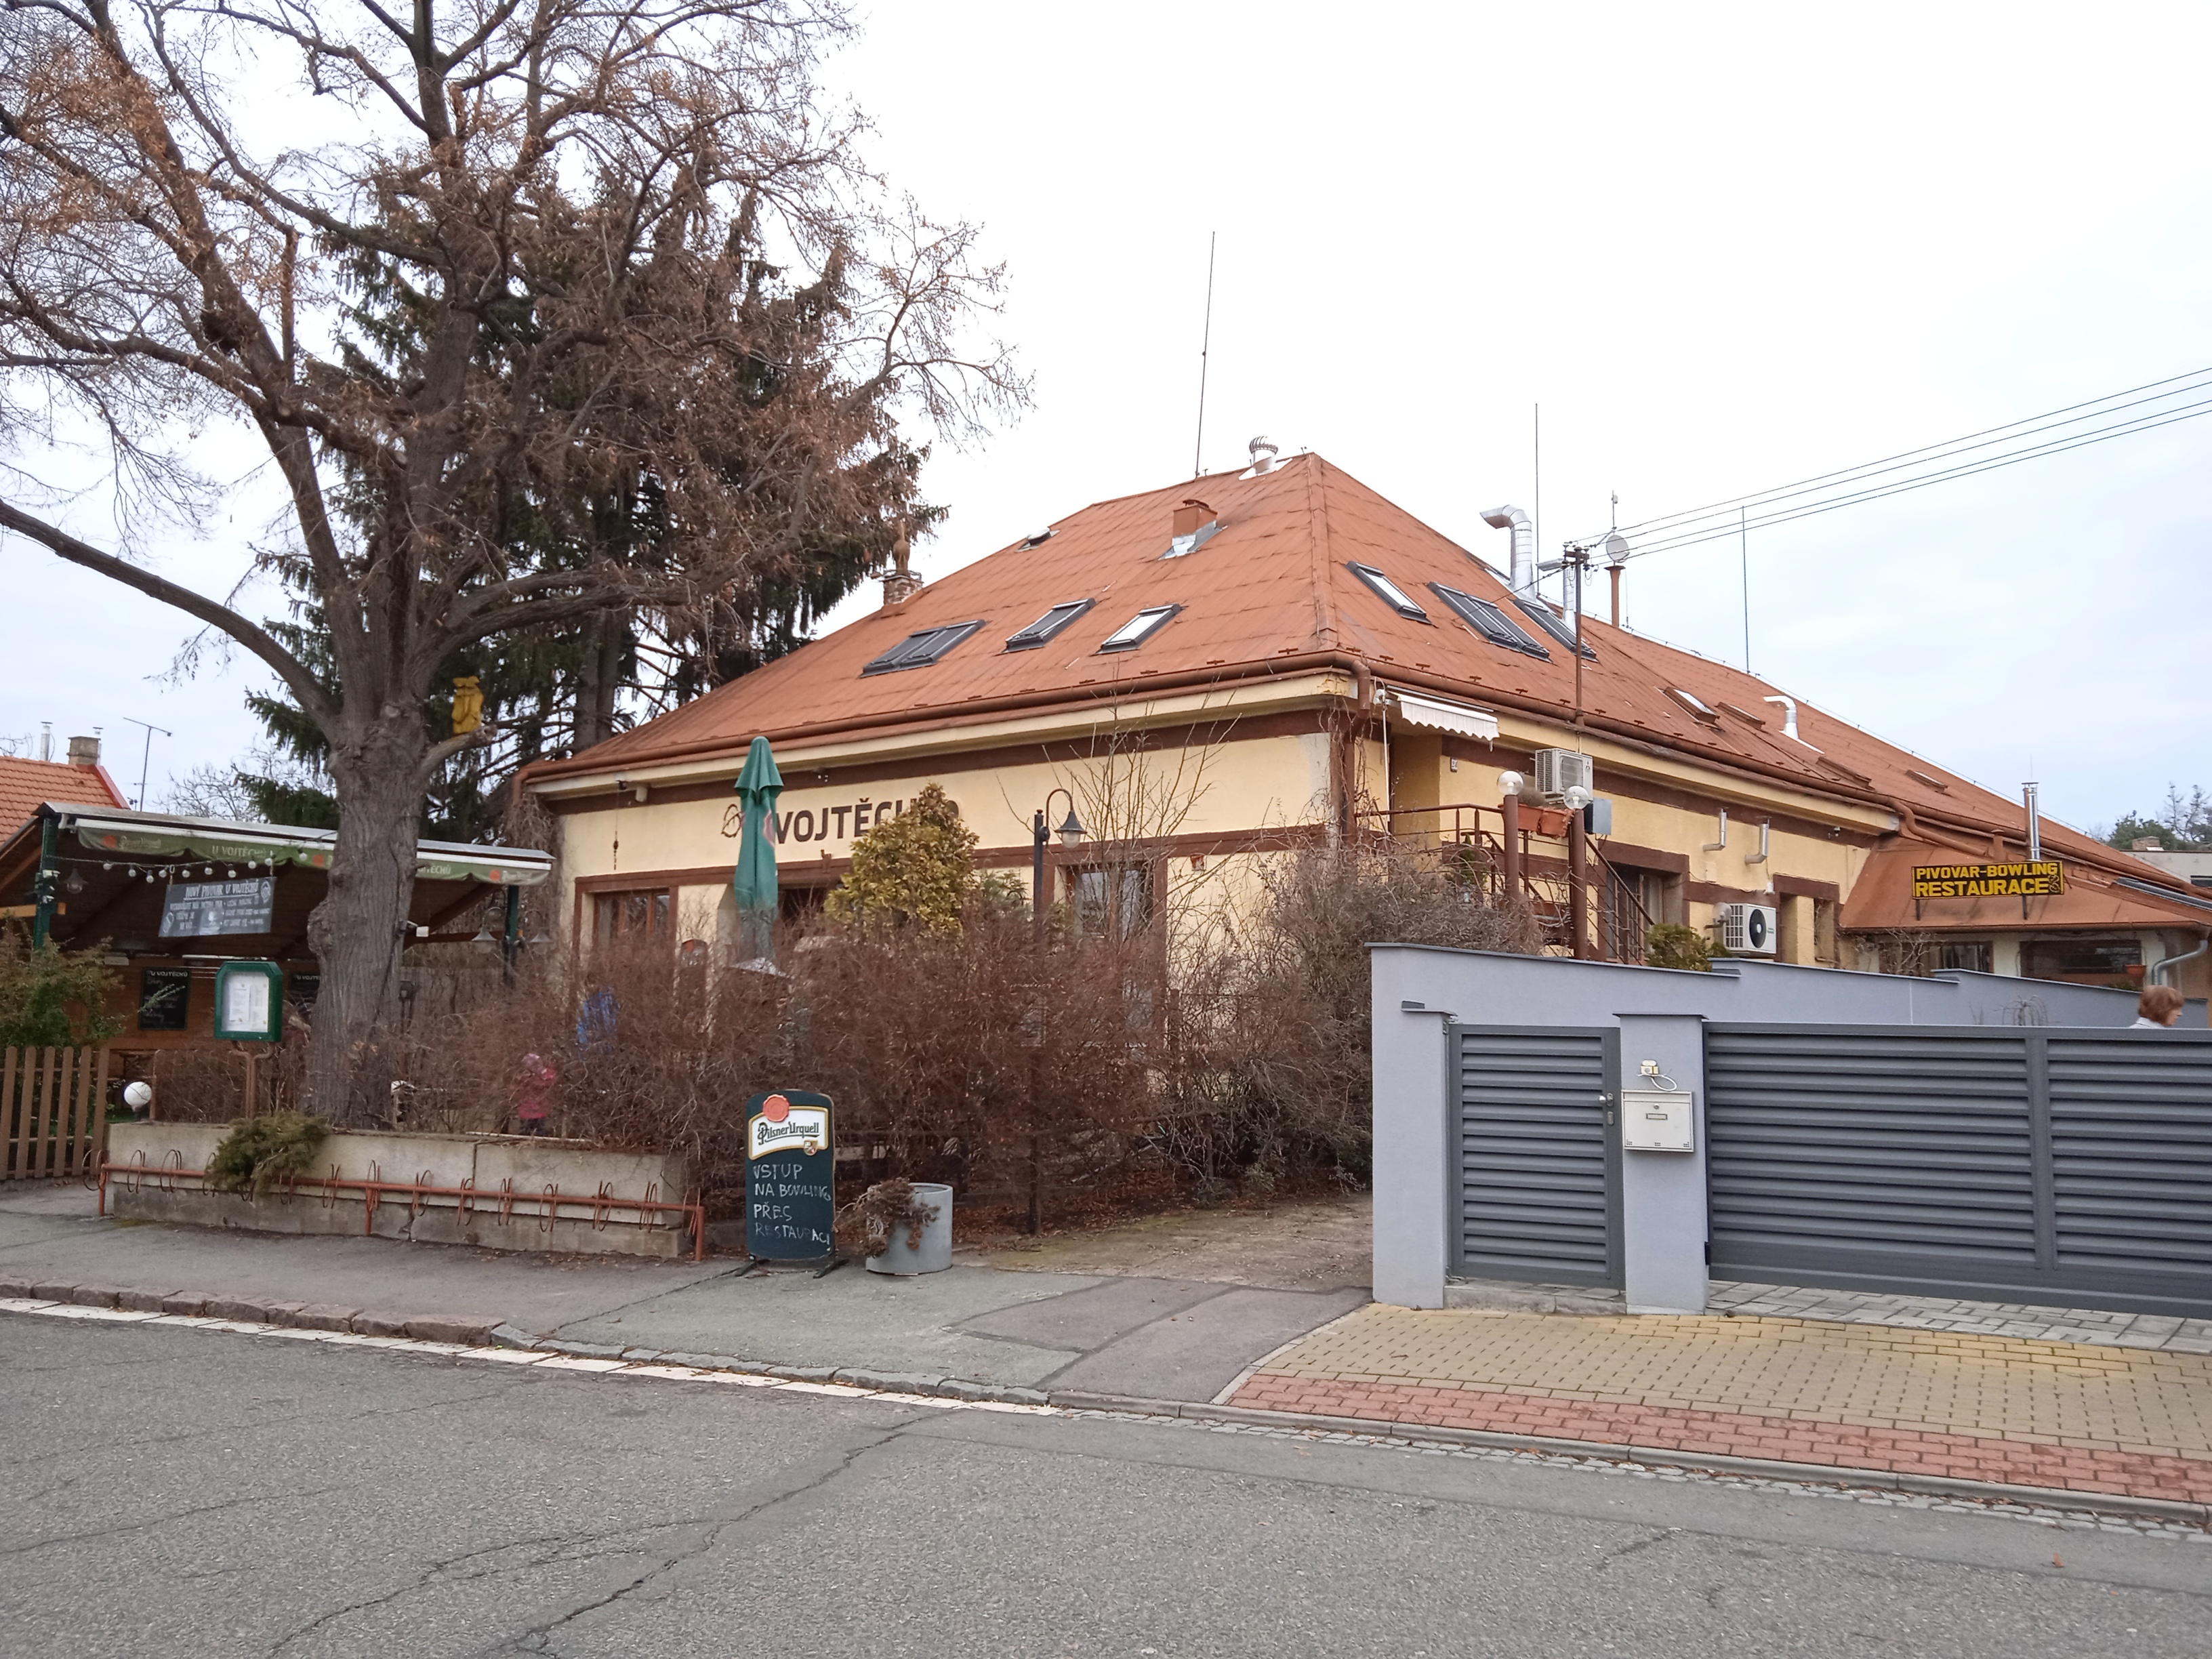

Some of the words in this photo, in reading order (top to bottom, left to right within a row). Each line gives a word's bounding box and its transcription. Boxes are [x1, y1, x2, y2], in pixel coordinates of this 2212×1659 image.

[1916, 863, 2057, 880] PIVOVAR-BOWLING
[1915, 878, 2049, 897] RESTAURACE
[757, 1122, 790, 1145] Pilsner
[788, 1122, 819, 1139] Urquell
[753, 1164, 803, 1180] VSTUP
[755, 1183, 775, 1196] NA
[754, 1202, 792, 1221] PŘES
